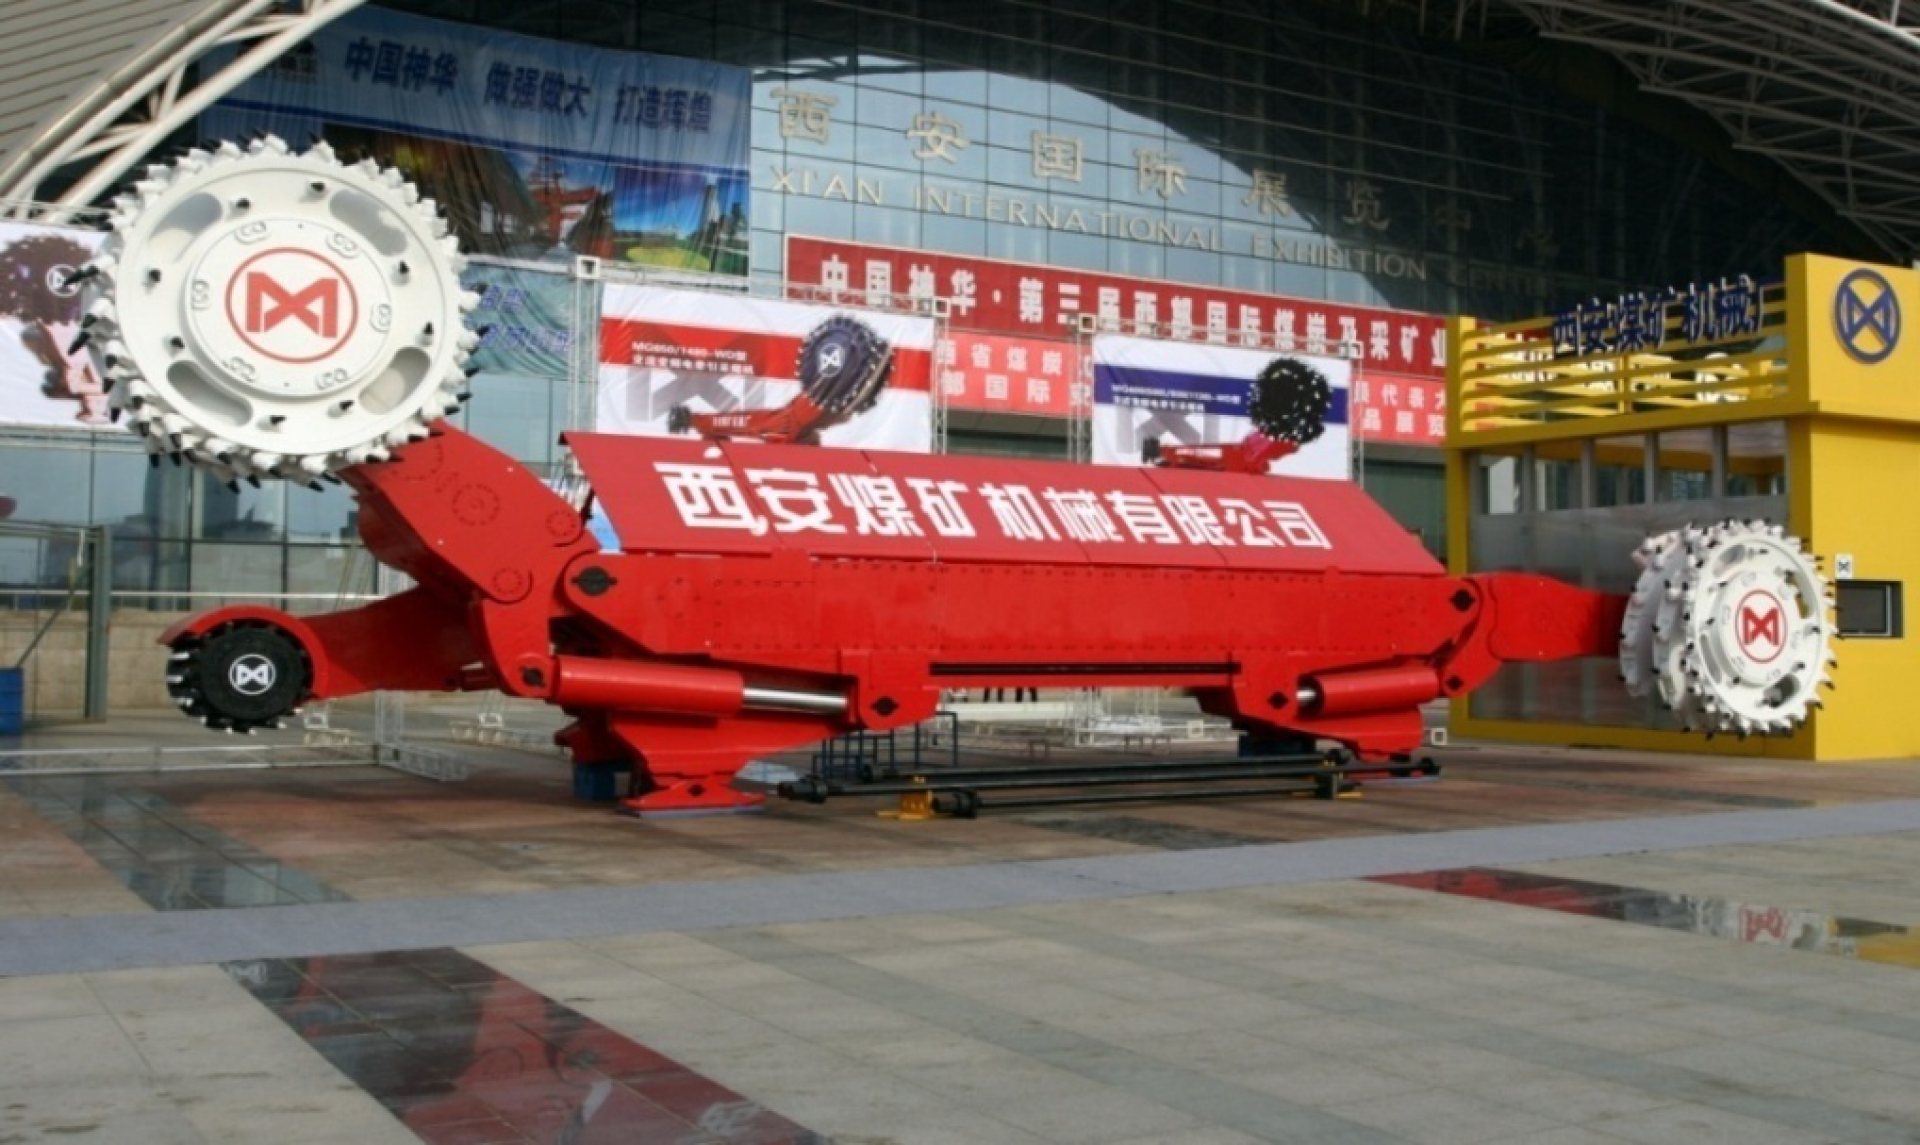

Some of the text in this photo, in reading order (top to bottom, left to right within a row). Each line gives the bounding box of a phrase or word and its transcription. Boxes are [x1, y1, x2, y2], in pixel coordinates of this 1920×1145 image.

[345, 36, 459, 96] 中国神华
[484, 60, 591, 119] 做强做大
[613, 82, 712, 135] 打造辉煌
[770, 164, 882, 205] XI'AN
[912, 184, 1223, 251] INTERNATIONAL
[1251, 231, 1428, 281] EXHIBITION
[653, 461, 1332, 550] 西安煤矿机械有限公司
